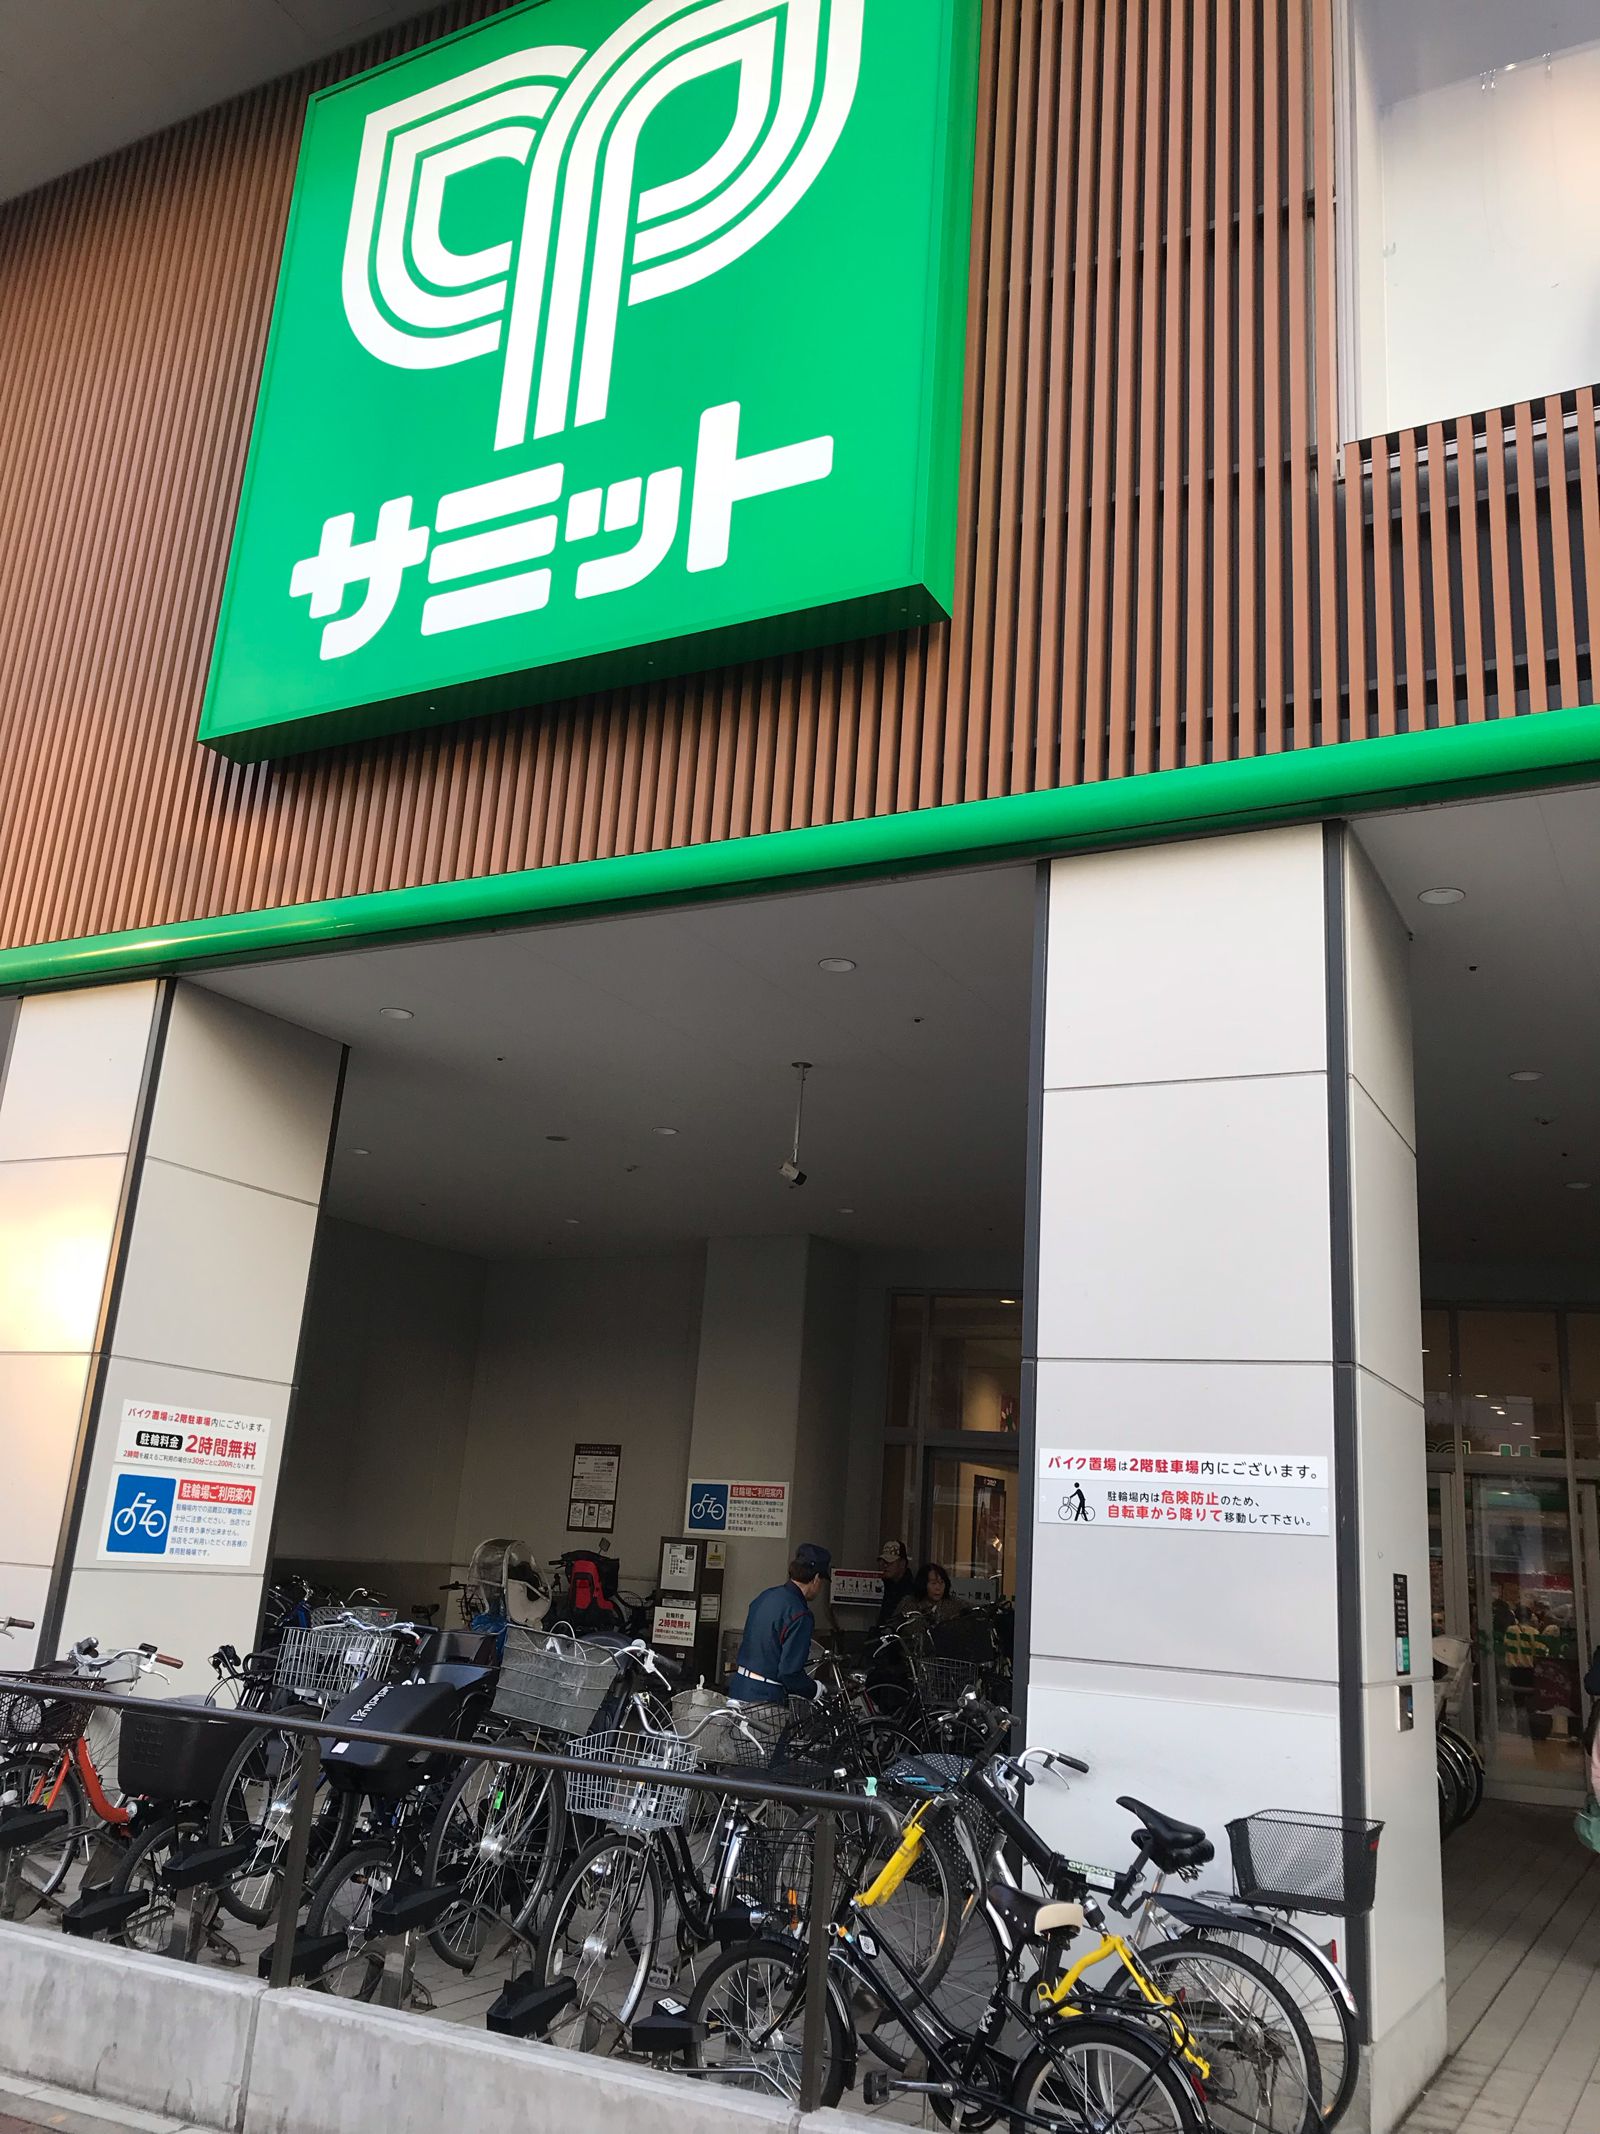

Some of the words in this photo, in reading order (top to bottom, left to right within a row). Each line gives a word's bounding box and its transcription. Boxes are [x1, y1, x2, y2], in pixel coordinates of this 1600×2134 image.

[289, 401, 834, 661] サミット
[128, 1407, 265, 1433] バイク置場は2階駐車場内にございます。
[139, 1432, 180, 1449] 駐輪料金
[185, 1434, 256, 1461] 2時間無料
[1048, 1456, 1317, 1480] バイク置場は2階駐車場内にございます。
[181, 1482, 253, 1503] 駐輪場ご利用案内
[1107, 1490, 1260, 1507] 駐輪場内は危険防止のため、
[1108, 1504, 1310, 1527] 自転車から降りて移動して下さい。
